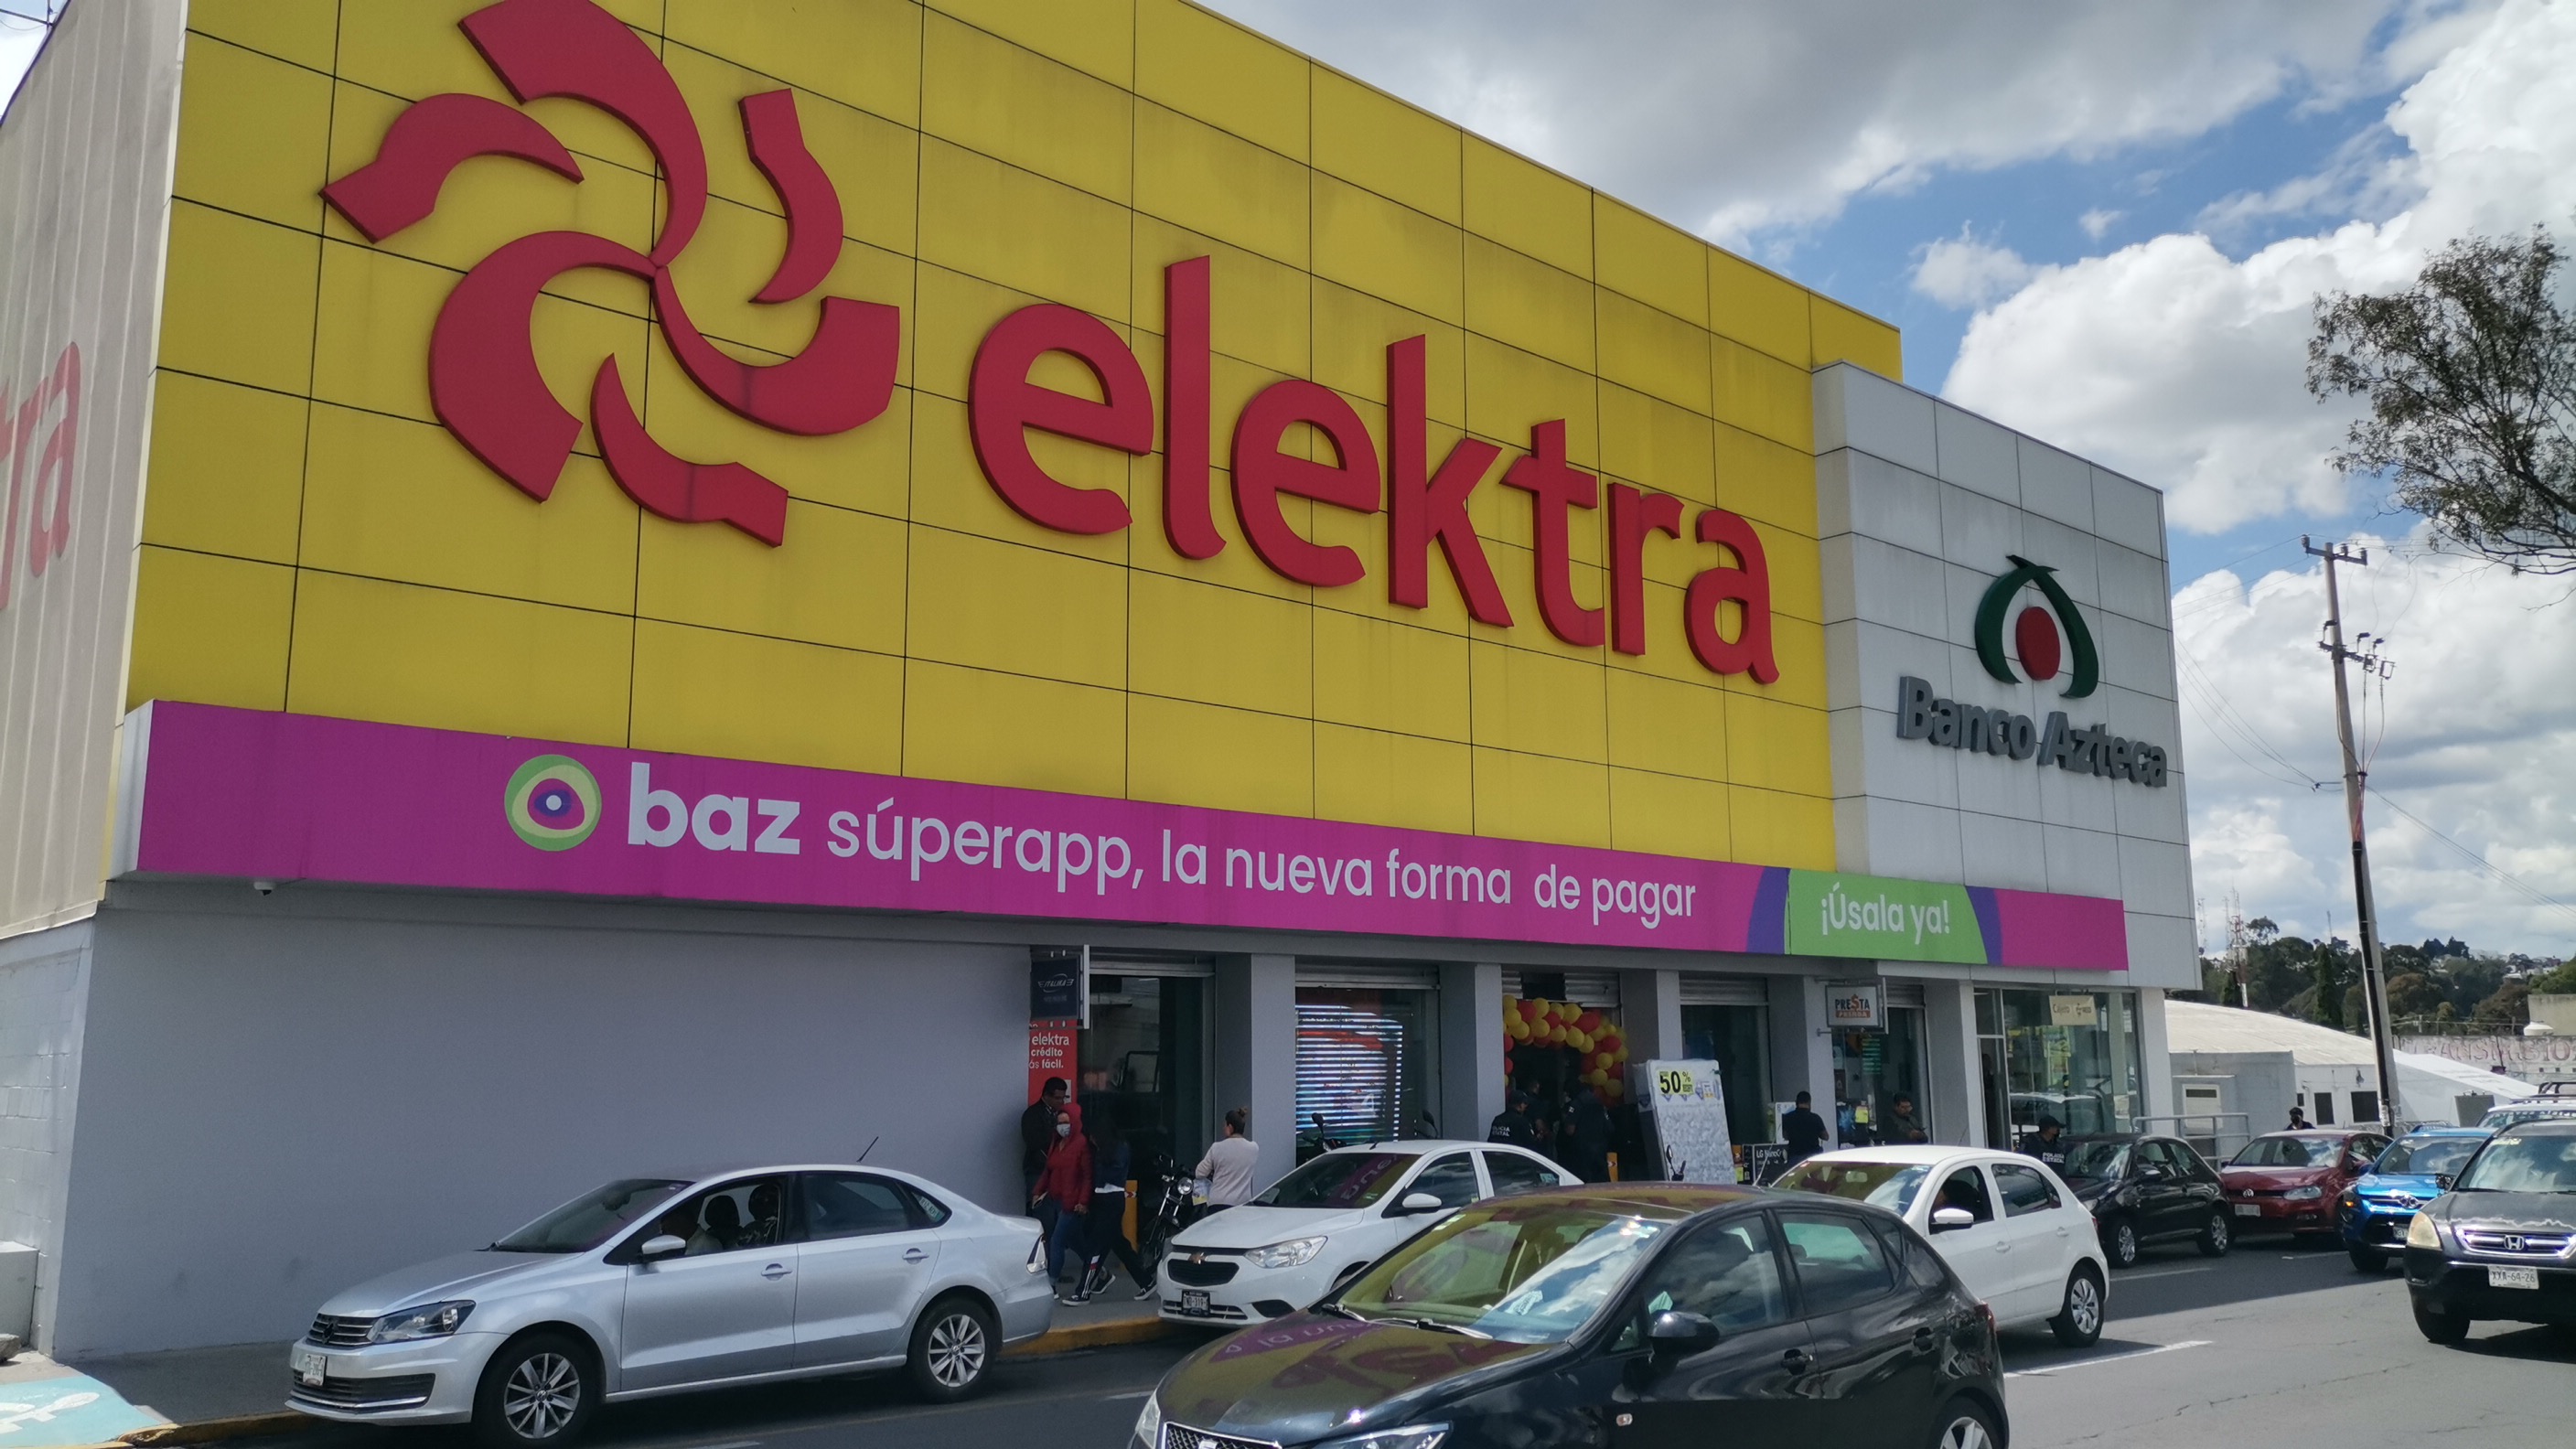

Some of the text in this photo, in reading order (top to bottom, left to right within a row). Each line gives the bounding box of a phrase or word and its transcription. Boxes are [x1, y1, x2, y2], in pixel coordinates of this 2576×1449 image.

[969, 254, 1780, 684] elektra
[1897, 676, 2167, 787] Banco Azteca
[628, 762, 1696, 929] baz súperapp, la nueva forma de pagar
[1821, 882, 1950, 944] ¡Úsala ya!
[1028, 1058, 1064, 1068] ás fácil.
[1031, 1046, 1063, 1057] crédito
[1032, 1032, 1069, 1046] elektra
